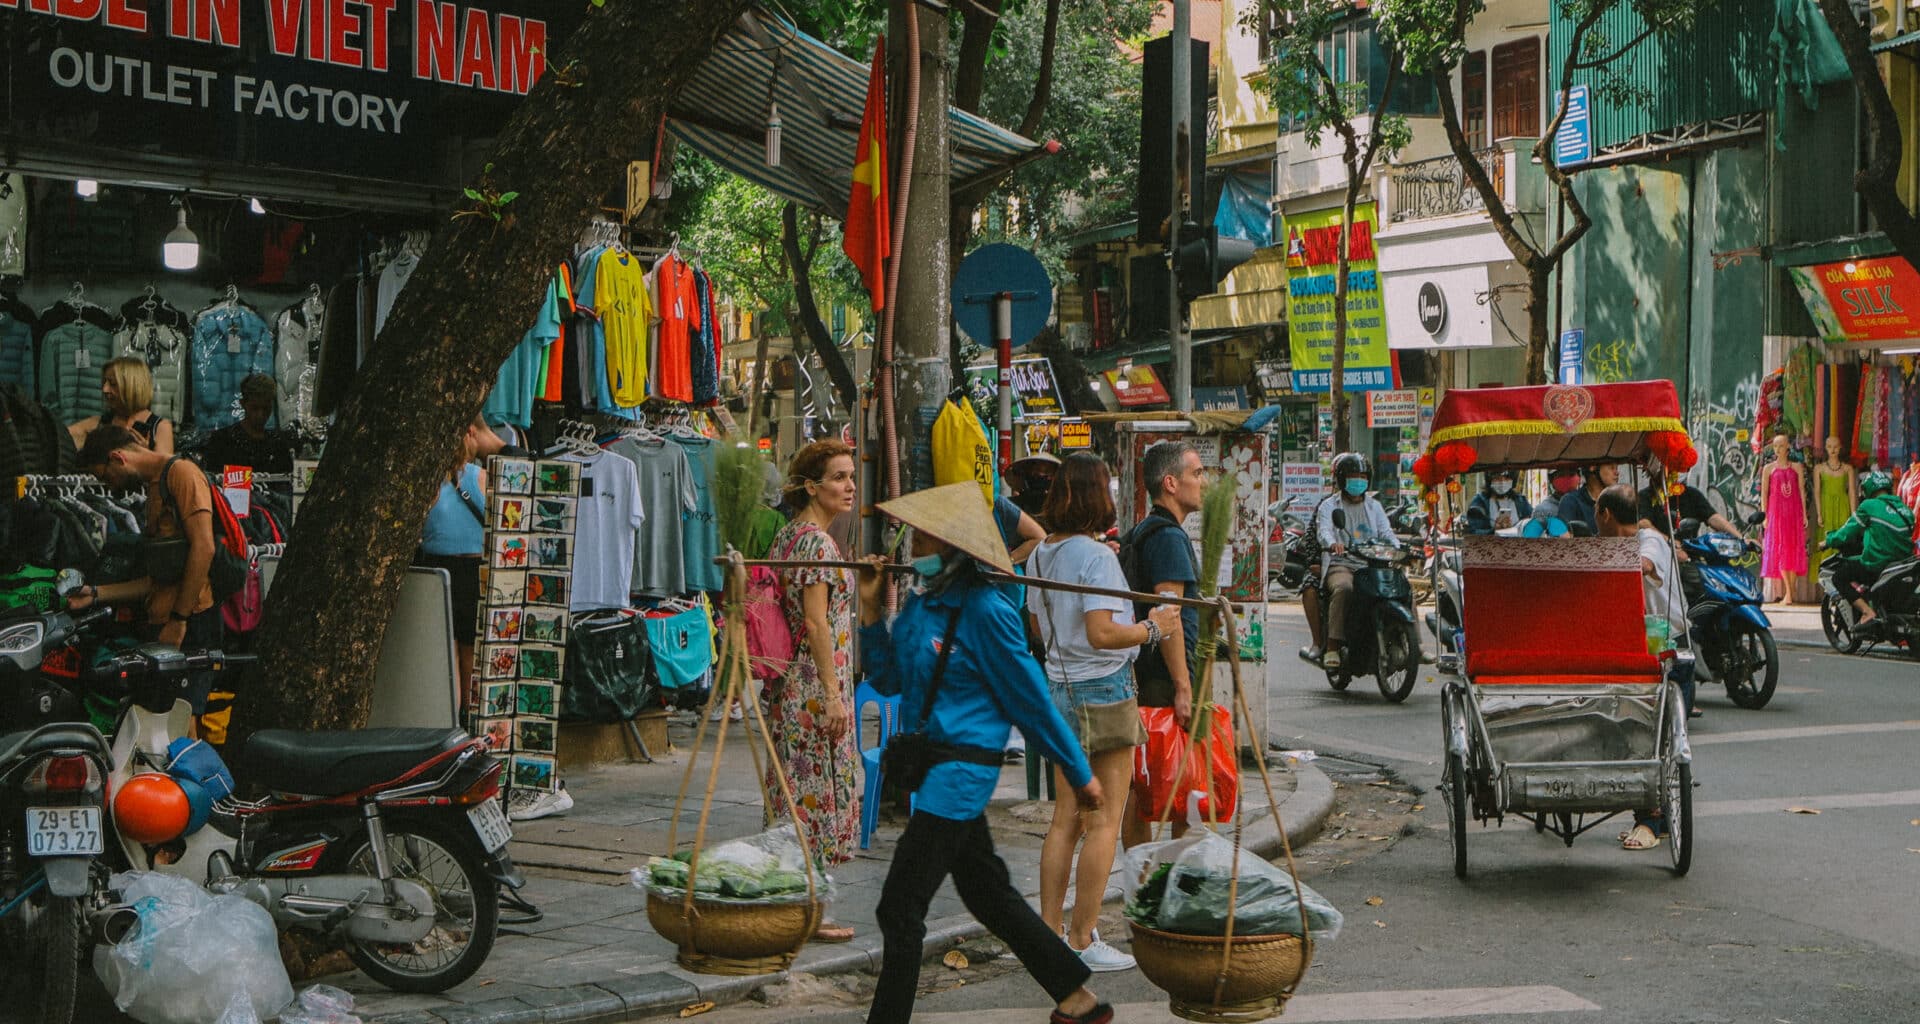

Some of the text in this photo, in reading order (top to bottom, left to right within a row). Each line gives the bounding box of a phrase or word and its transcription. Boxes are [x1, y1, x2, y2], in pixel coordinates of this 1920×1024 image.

[265, 0, 396, 73] VIET
[412, 0, 546, 96] NAM
[50, 47, 409, 134] OUTLET FACTORY
[1841, 284, 1904, 317] SILK
[1299, 373, 1308, 386] WE
[1362, 371, 1373, 384] FOR
[1373, 370, 1385, 384] YOU
[227, 470, 244, 484] SALE
[976, 462, 991, 484] 20
[38, 809, 90, 830] 29-E1
[33, 830, 97, 852] 073.27
